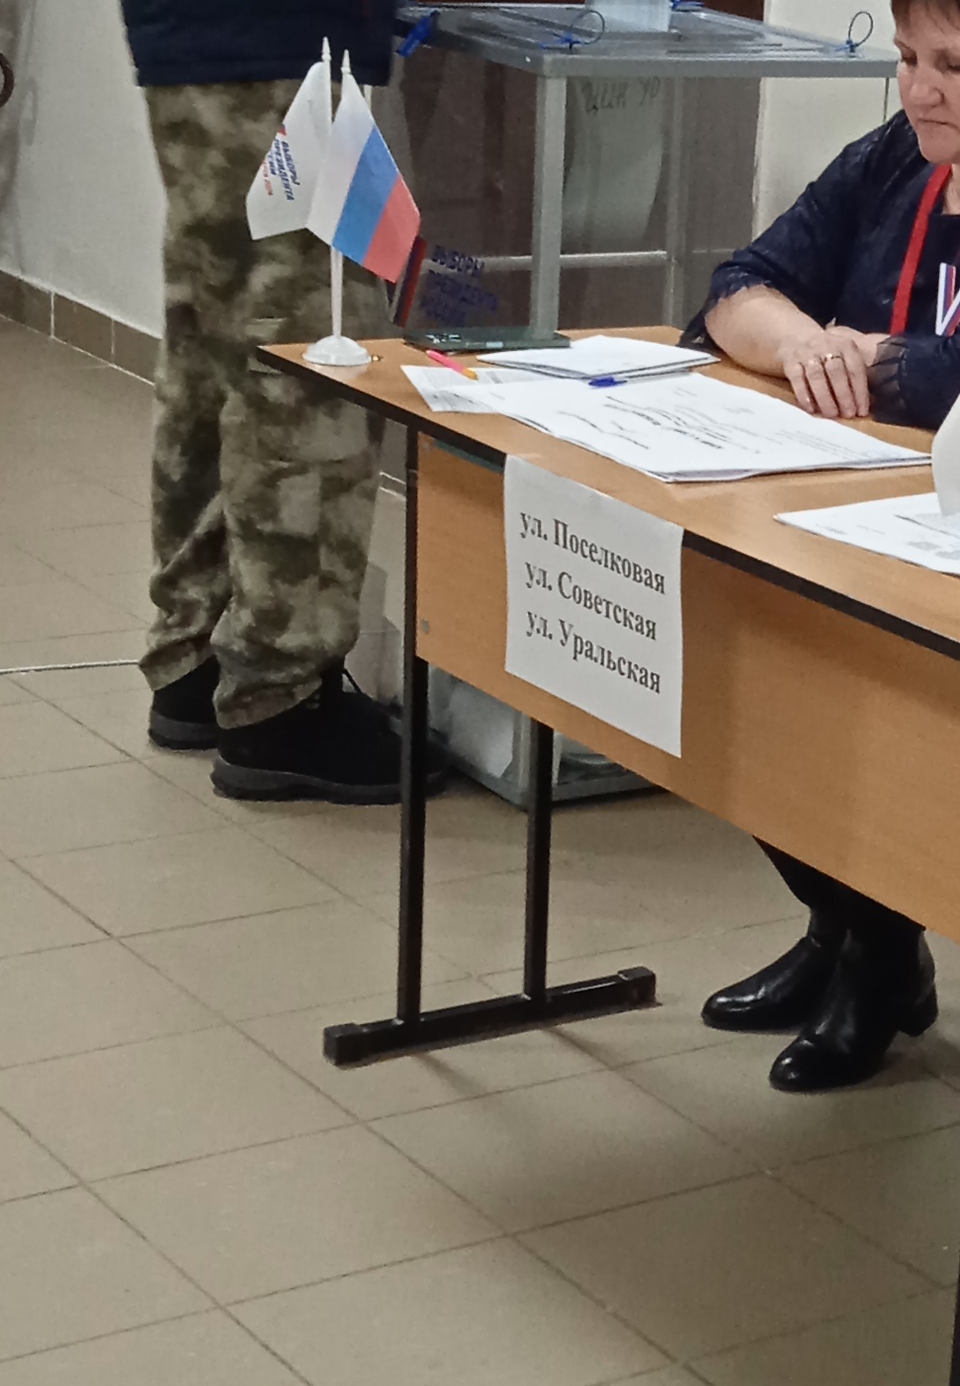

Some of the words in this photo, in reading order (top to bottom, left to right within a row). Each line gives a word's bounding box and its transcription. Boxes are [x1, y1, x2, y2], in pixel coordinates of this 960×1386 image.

[520, 512, 549, 541] ул.
[552, 518, 666, 595] Поселковая
[524, 561, 553, 592] ул.
[557, 571, 658, 641] Советская
[525, 611, 554, 641] ул.
[558, 618, 662, 695] Уральская
